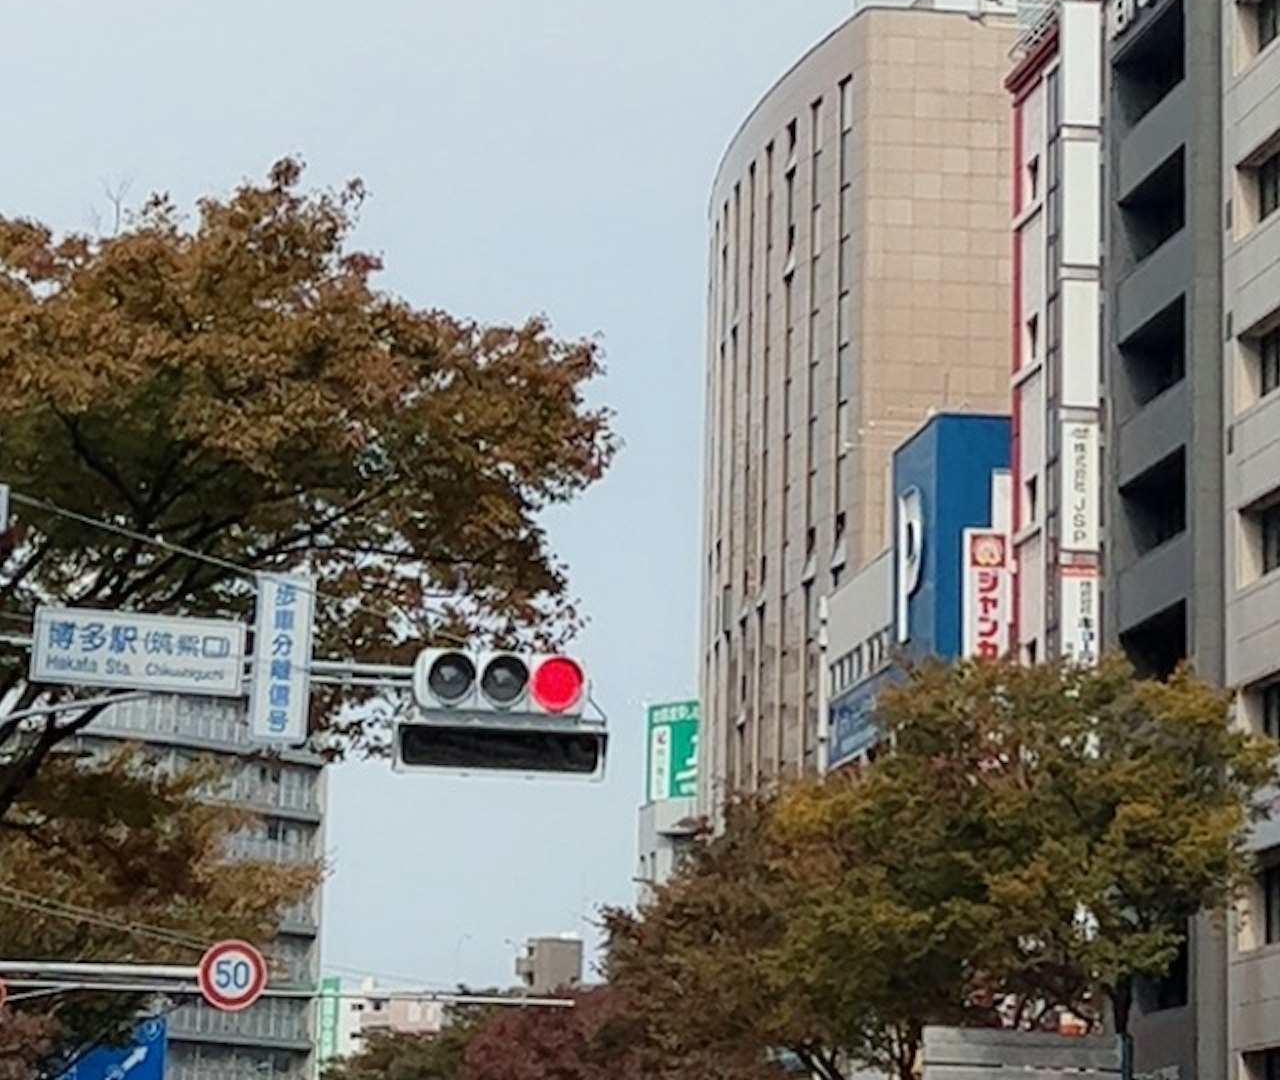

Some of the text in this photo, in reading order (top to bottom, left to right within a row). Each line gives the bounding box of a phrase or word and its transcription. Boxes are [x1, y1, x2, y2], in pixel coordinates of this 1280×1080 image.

[45, 654, 98, 674] Hakata
[268, 583, 297, 733] 歩車分離信号
[214, 961, 249, 991] 50
